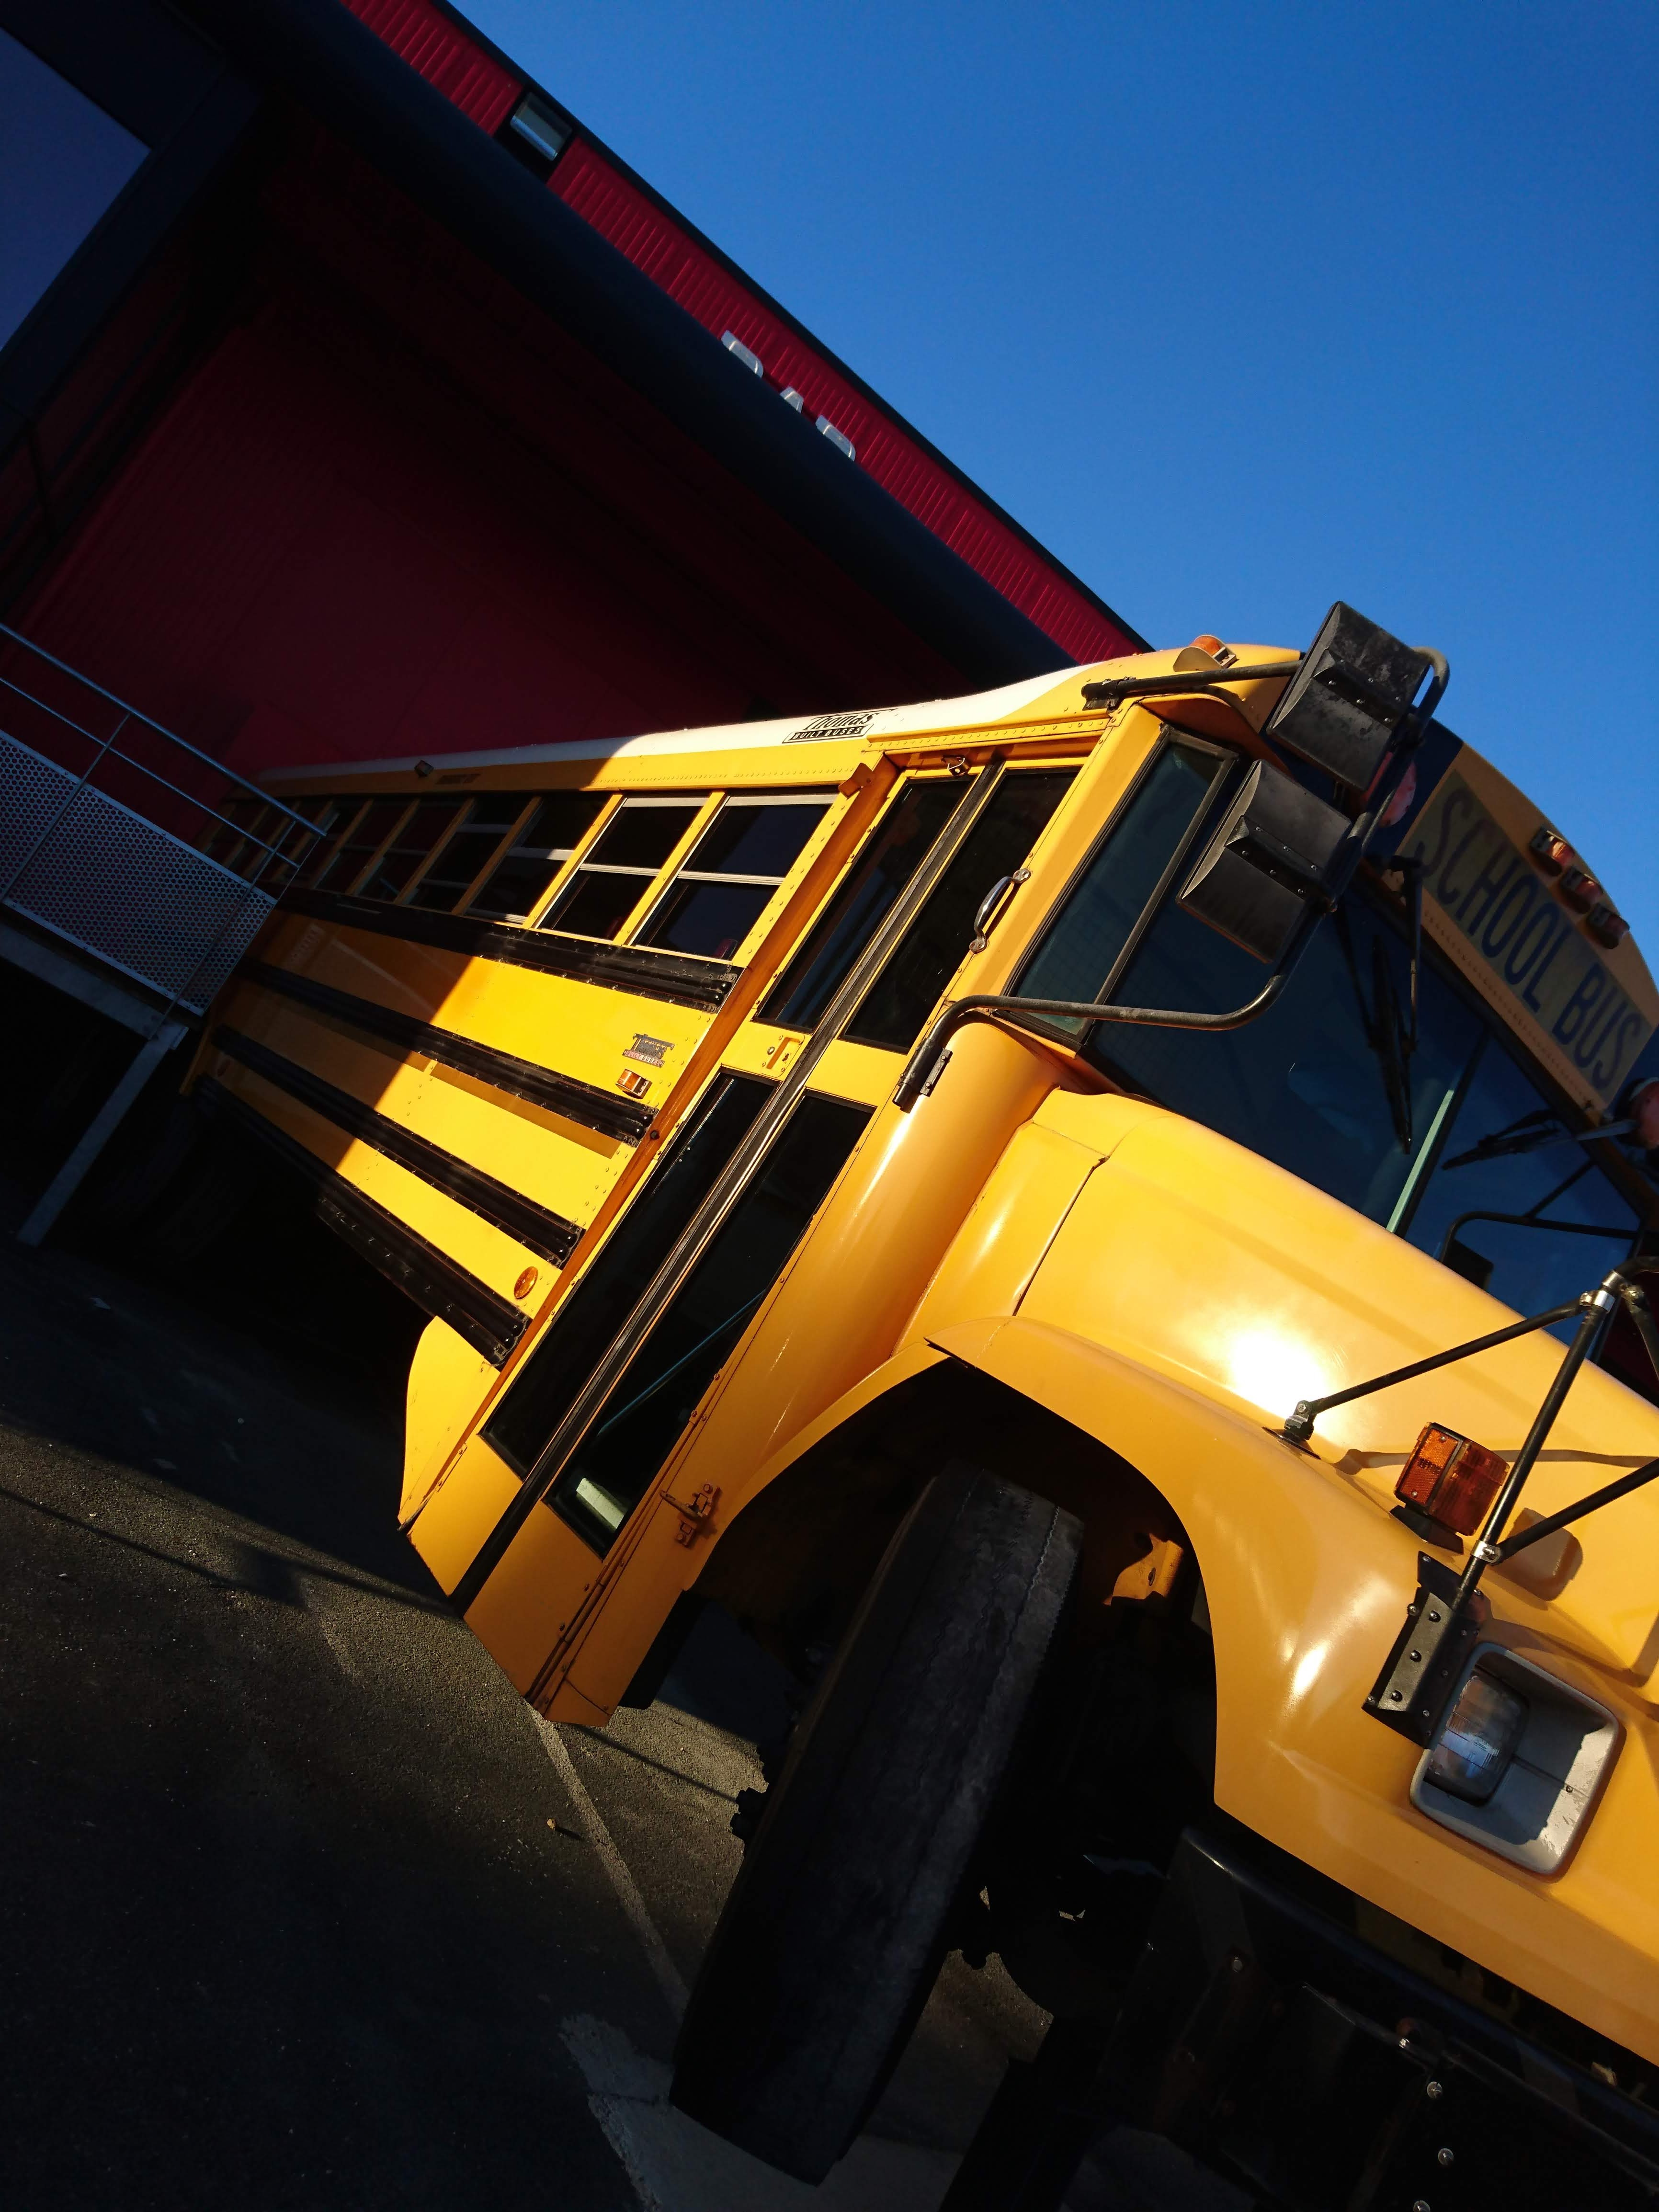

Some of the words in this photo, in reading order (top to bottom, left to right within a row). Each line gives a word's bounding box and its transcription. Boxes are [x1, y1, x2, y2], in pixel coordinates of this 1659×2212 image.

[803, 709, 895, 730] Thomas
[824, 727, 862, 736] BUSES
[1413, 788, 1571, 1012] SCHOOL
[1551, 963, 1641, 1089] BUS
[642, 1056, 659, 1065] BUSES
